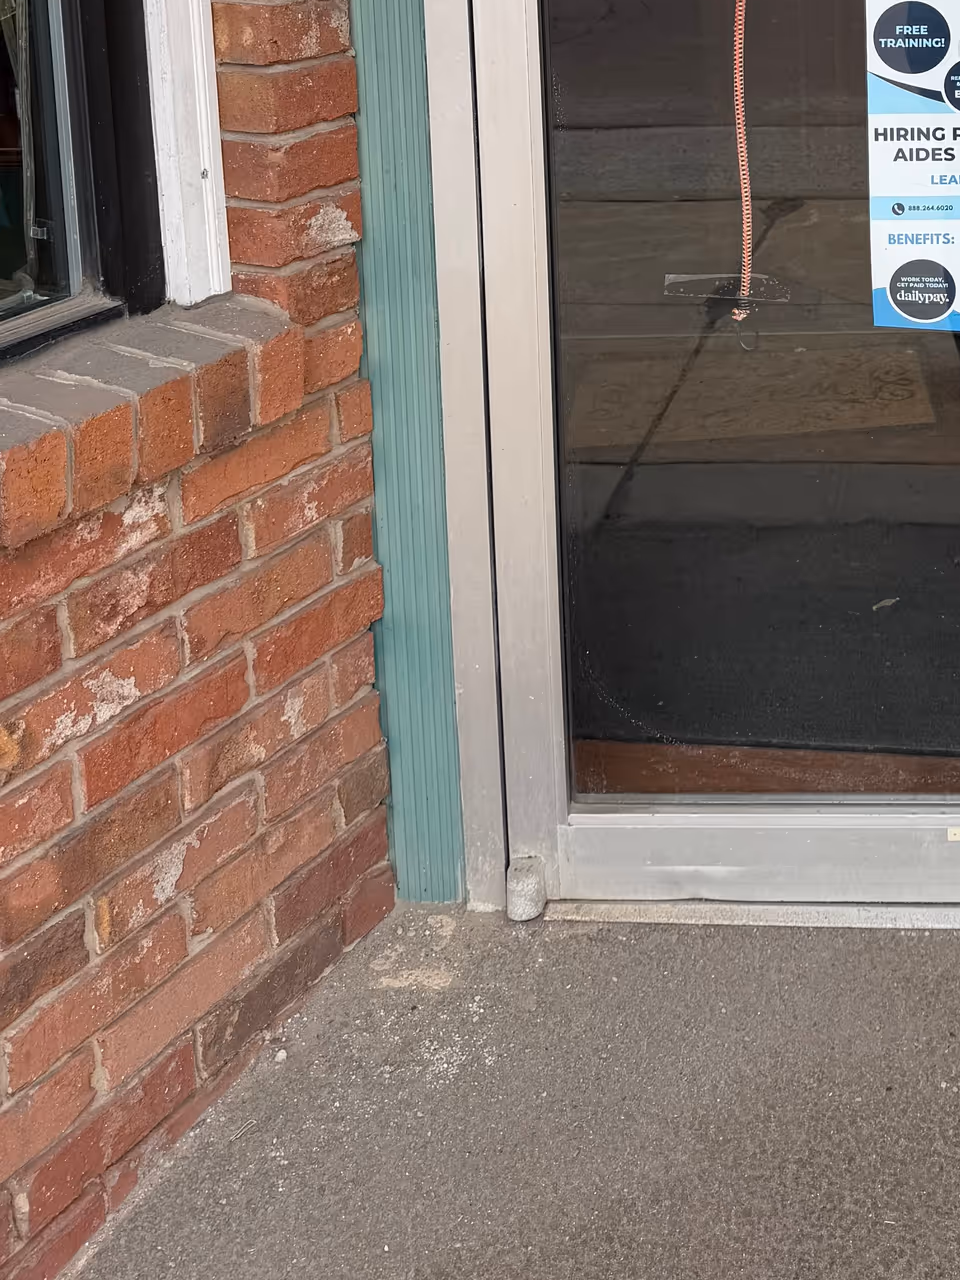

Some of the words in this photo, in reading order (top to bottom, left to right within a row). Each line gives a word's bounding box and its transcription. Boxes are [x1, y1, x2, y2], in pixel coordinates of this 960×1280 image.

[895, 25, 928, 35] FREE
[879, 37, 945, 48] TRAINING!
[873, 127, 946, 142] HIRING
[893, 147, 956, 162] AIDES
[888, 233, 955, 245] BENEFITS:
